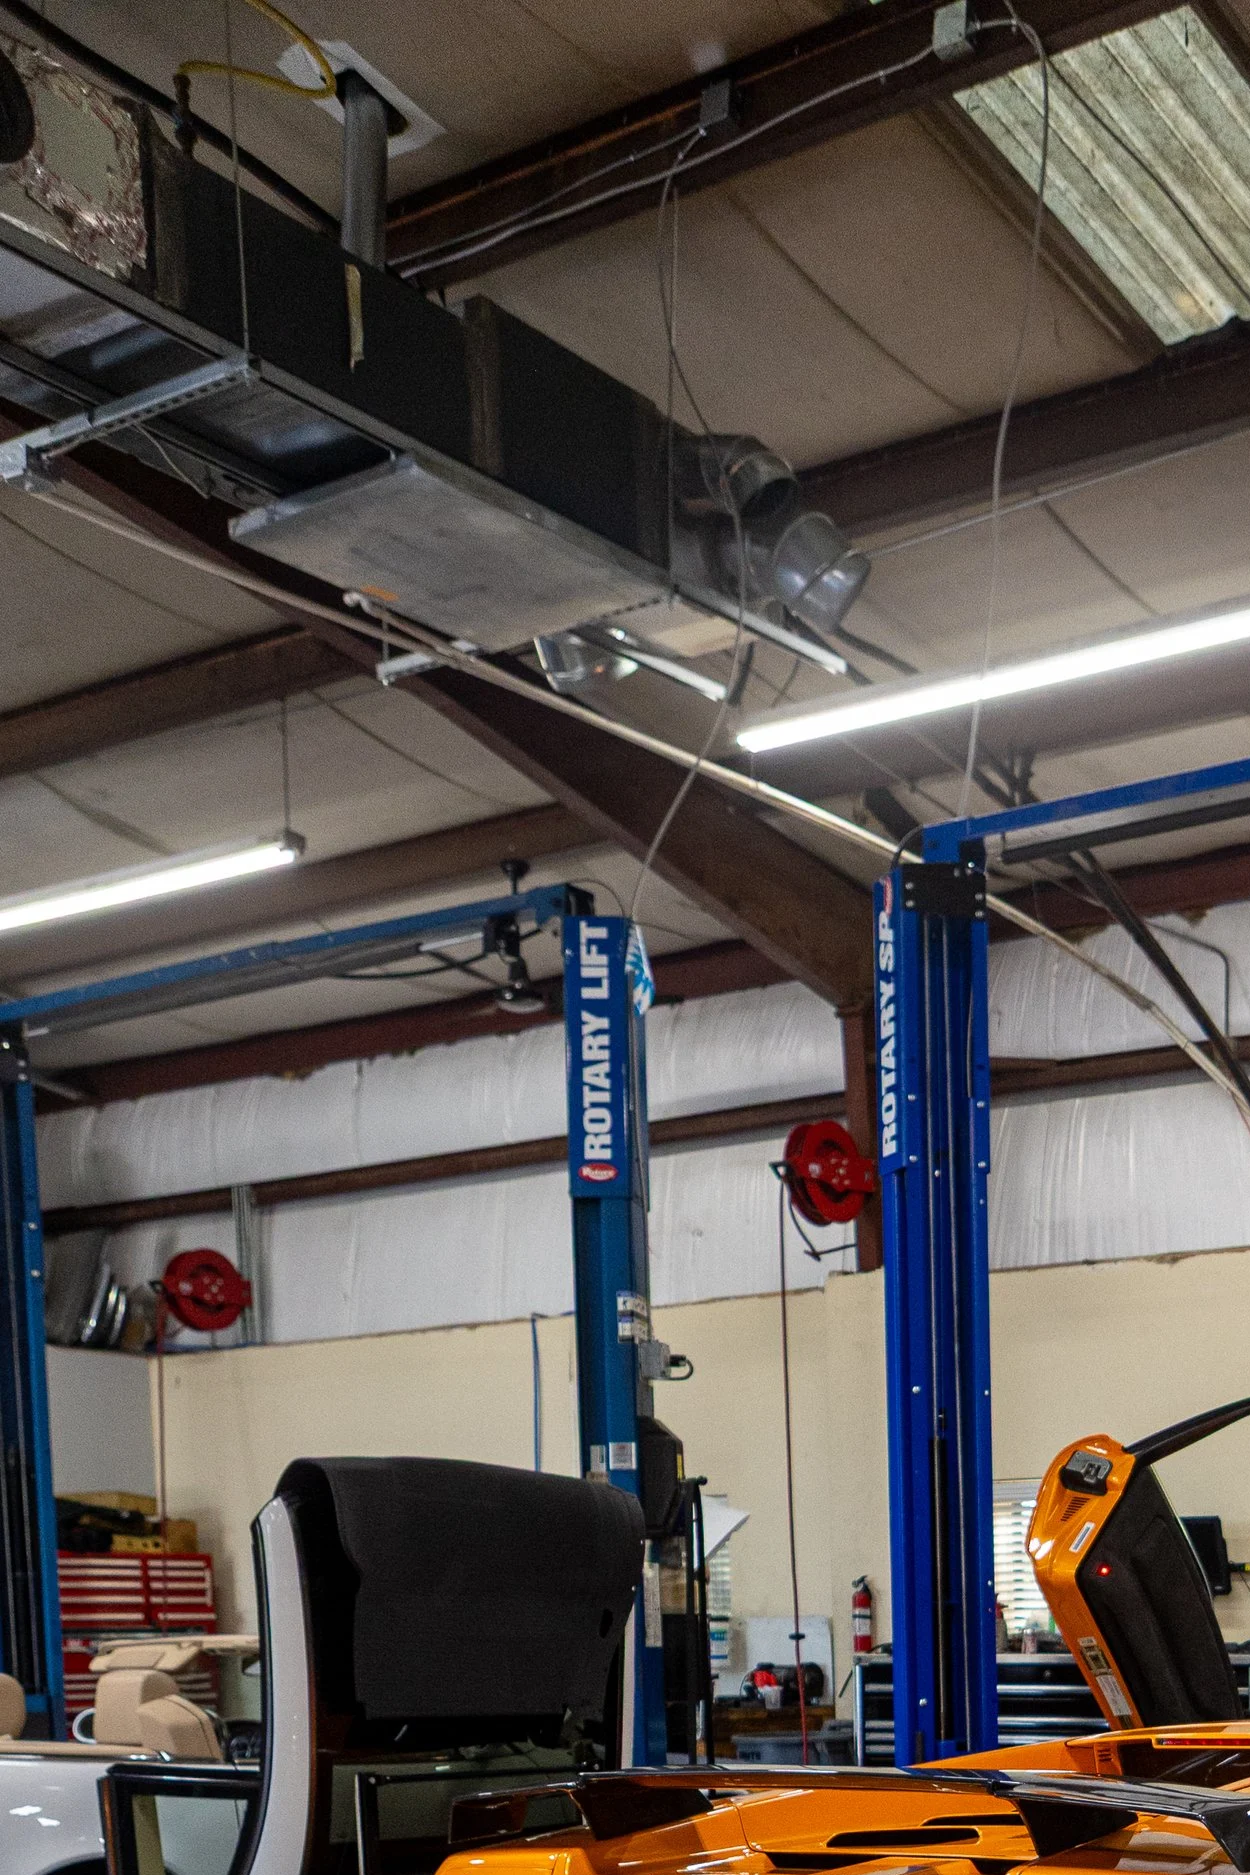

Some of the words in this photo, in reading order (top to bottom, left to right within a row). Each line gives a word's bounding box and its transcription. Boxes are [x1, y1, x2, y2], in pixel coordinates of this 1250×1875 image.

[579, 920, 609, 999] LIFT
[878, 911, 895, 973] SP
[581, 1010, 613, 1160] ROTARY
[879, 979, 897, 1158] ROTARY
